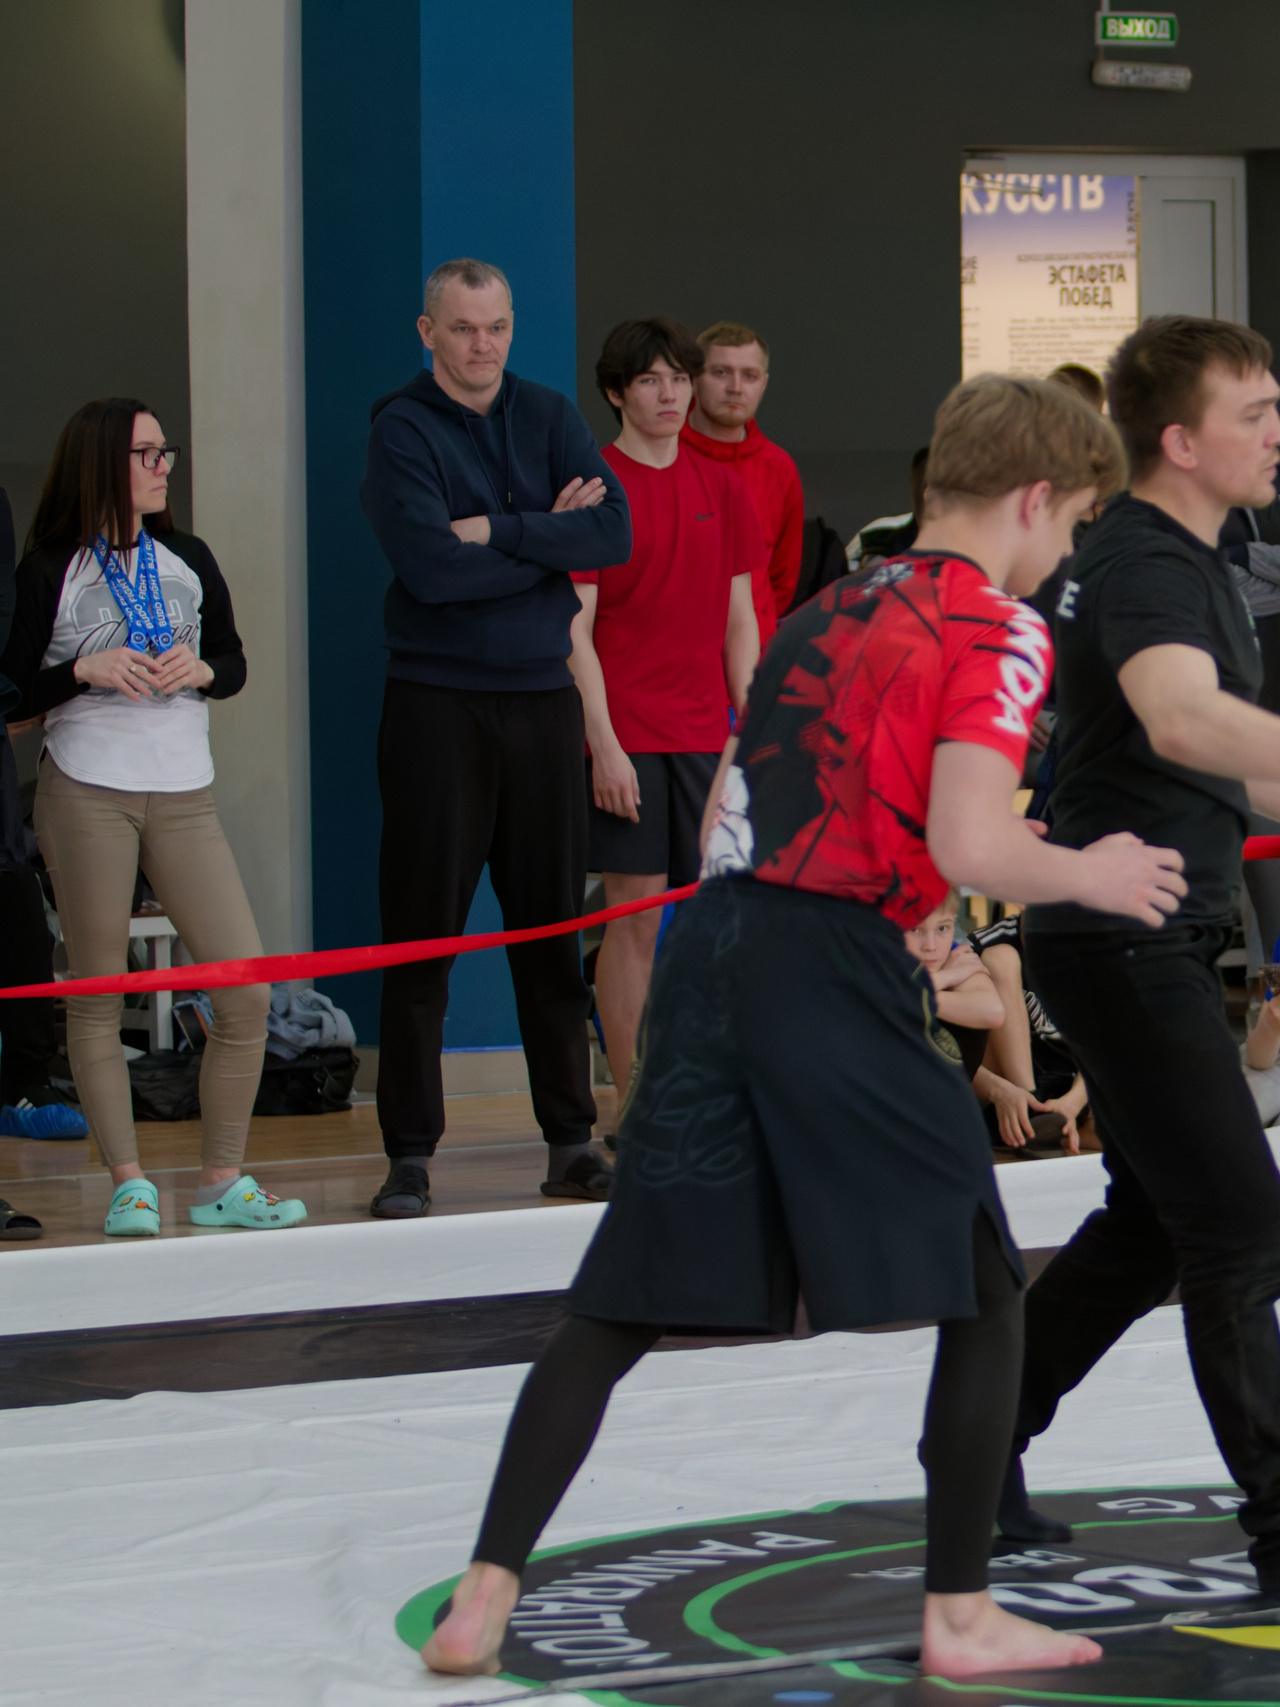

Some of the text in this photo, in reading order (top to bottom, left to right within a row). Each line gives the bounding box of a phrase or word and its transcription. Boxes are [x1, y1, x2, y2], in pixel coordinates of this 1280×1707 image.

[1106, 18, 1171, 39] ВЫХОД
[1048, 264, 1127, 285] ЭСТАФЕТА
[1059, 286, 1113, 309] ПОБЕД
[116, 578, 138, 603] FIGHT
[139, 573, 149, 600] FIGHT
[151, 573, 161, 600] FIGHT
[134, 603, 155, 630] BUDO
[155, 601, 168, 628] BUDO
